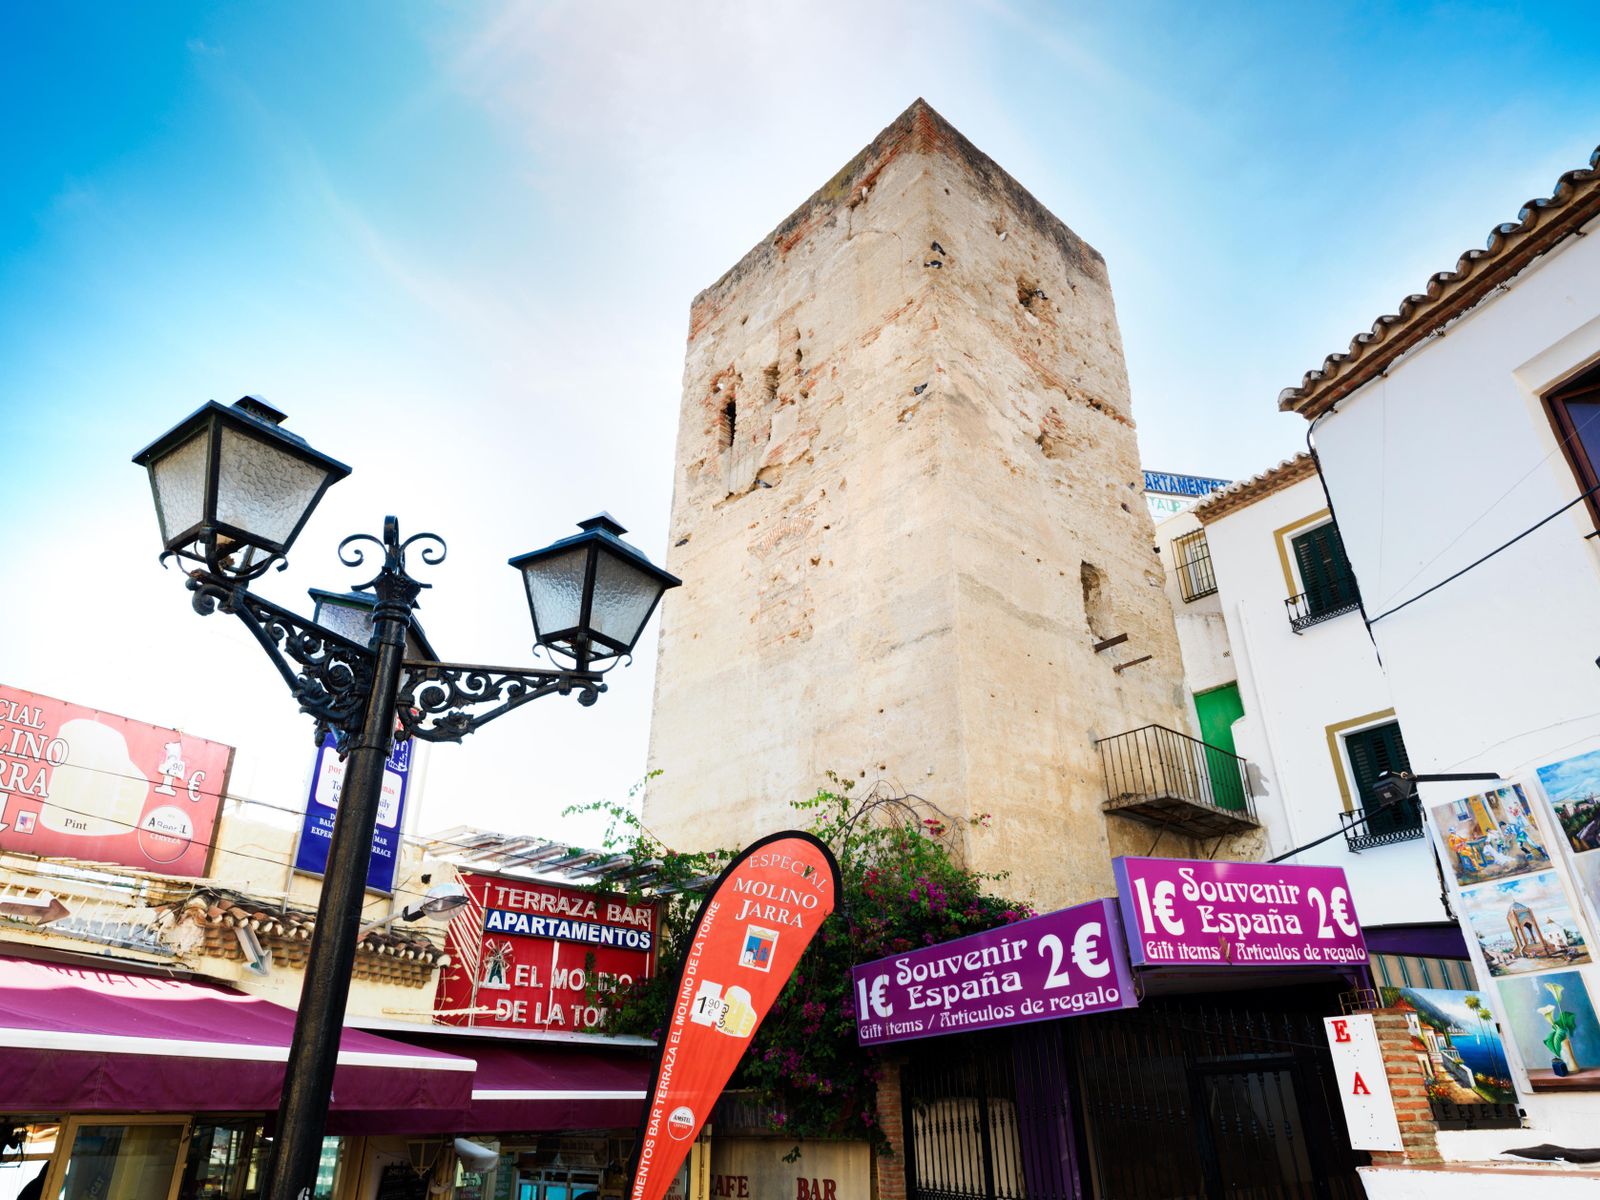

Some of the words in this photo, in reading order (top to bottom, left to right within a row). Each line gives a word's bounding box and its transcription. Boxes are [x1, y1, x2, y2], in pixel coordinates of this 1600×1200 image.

[733, 877, 818, 909] MOLINO
[1178, 867, 1300, 905] Souvenir
[495, 886, 598, 919] TERRAZA
[607, 903, 652, 927] BAR
[697, 901, 720, 940] TORRE
[735, 899, 803, 928] JARRA
[487, 910, 651, 950] APARTAMENTOS
[1197, 905, 1303, 940] España
[695, 941, 704, 956] LA
[896, 938, 1028, 986] Souvenir
[1146, 940, 1174, 960] Gift
[1177, 942, 1221, 960] items
[1236, 942, 1300, 961] Articulos
[1303, 944, 1321, 960] de
[1323, 945, 1366, 963] regalo
[514, 964, 543, 988] EL
[551, 968, 633, 995] MOINO
[687, 957, 699, 976] DE
[675, 977, 694, 1026] MOLINO
[907, 971, 1023, 1010] España
[495, 998, 528, 1023] DE
[535, 1002, 565, 1025] LA
[860, 1025, 882, 1040] Gift
[886, 1017, 923, 1037] items
[940, 1003, 1015, 1028] Articulos
[1021, 998, 1045, 1016] de
[1050, 985, 1120, 1012] regalo
[671, 1028, 682, 1044] EL
[1331, 1019, 1351, 1043] E
[655, 1047, 678, 1105] TERRAZA
[1352, 1072, 1371, 1095] A
[648, 1109, 662, 1136] BAR
[796, 1177, 837, 1200] BAR
